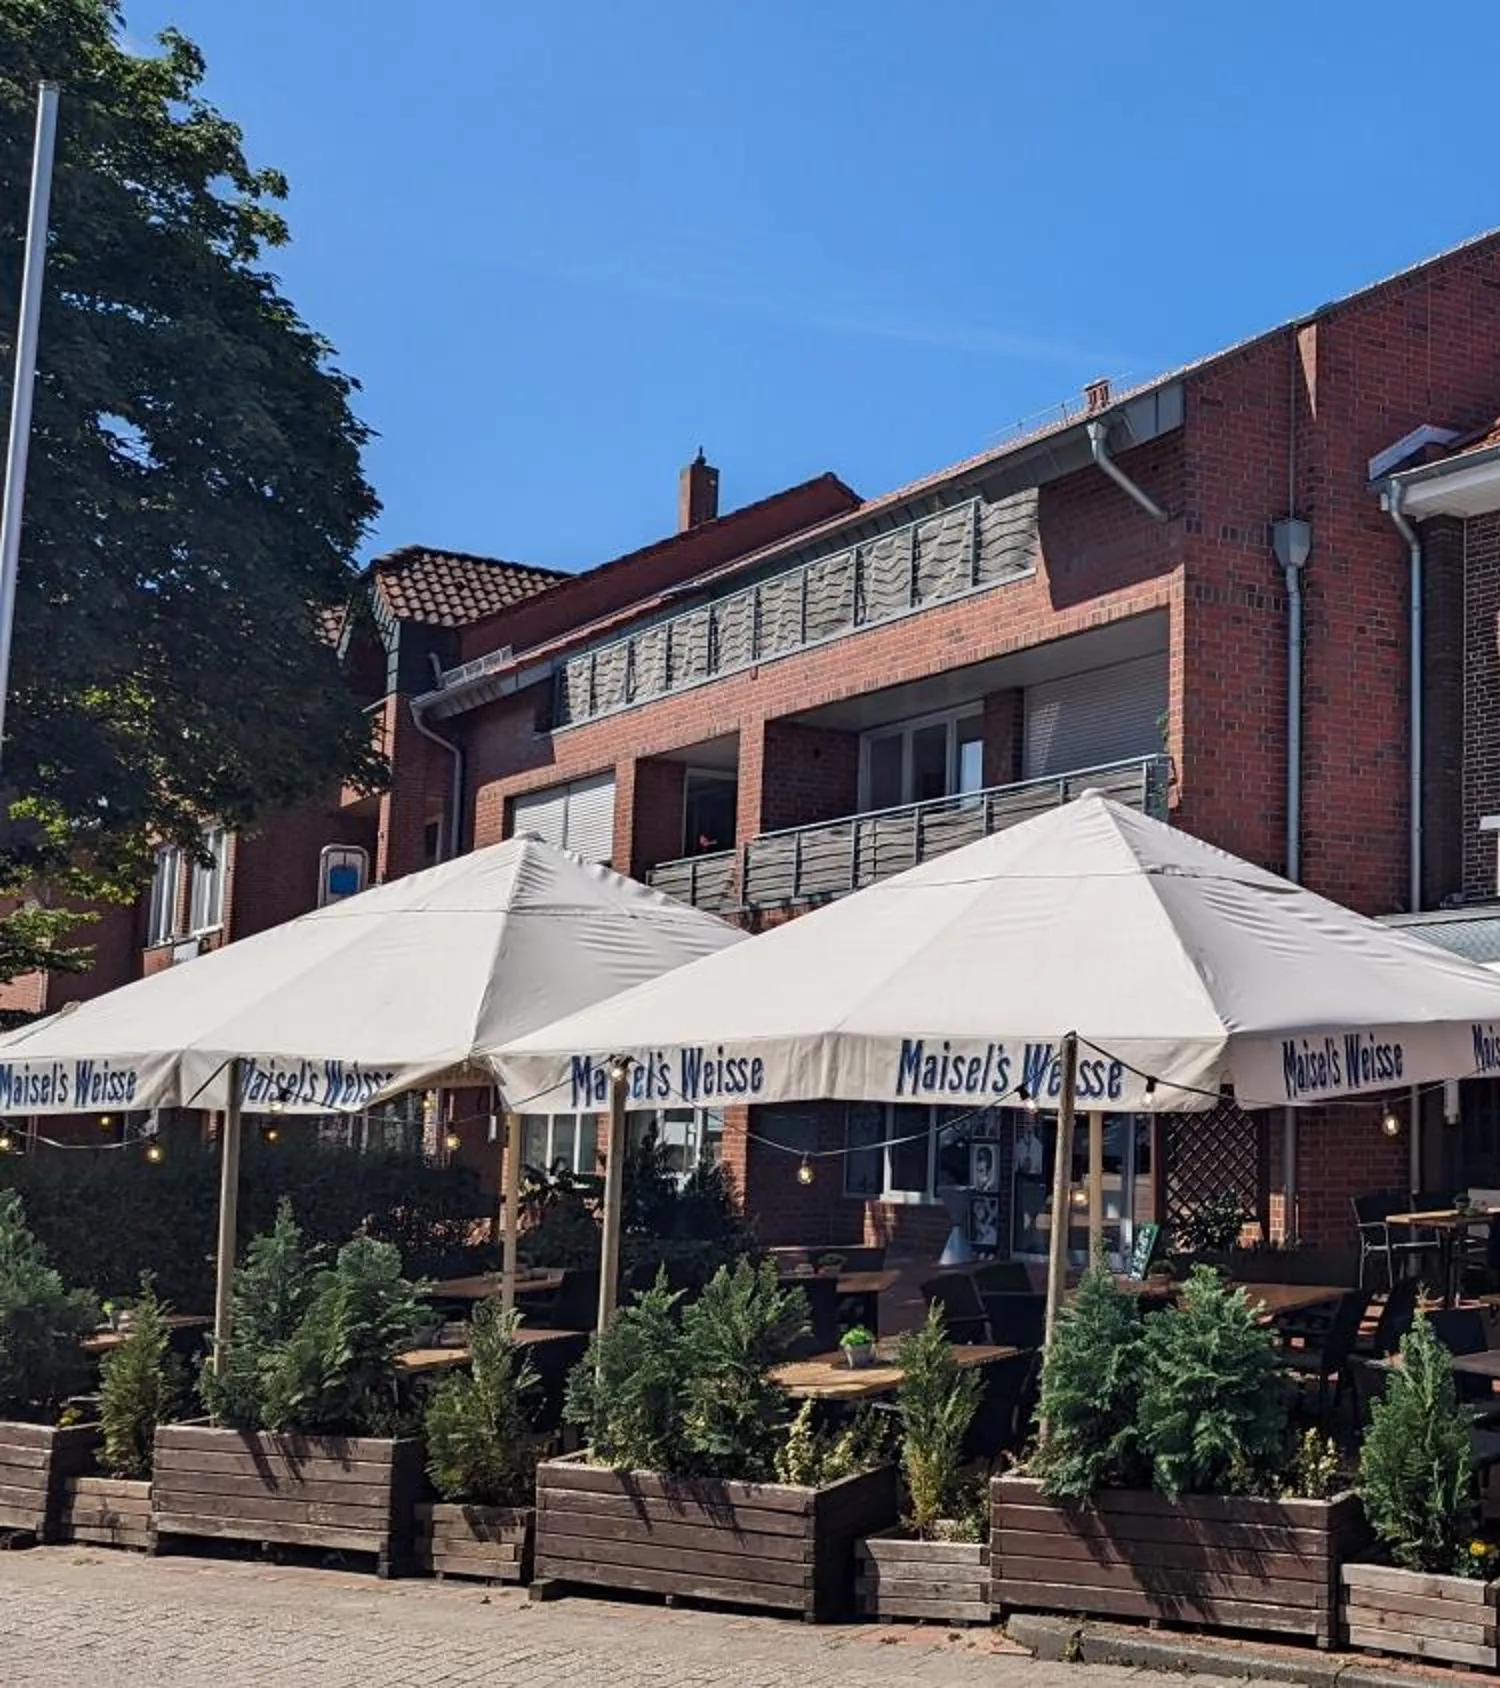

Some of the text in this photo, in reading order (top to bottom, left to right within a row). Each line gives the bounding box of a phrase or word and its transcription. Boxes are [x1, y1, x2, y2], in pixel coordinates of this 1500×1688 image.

[0, 1059, 138, 1109] Maisel's Weisse
[571, 1045, 765, 1107] Mael's Weisse
[896, 1038, 1124, 1099] Maisel's Wesse
[1281, 1031, 1403, 1099] Maisel's Weisse
